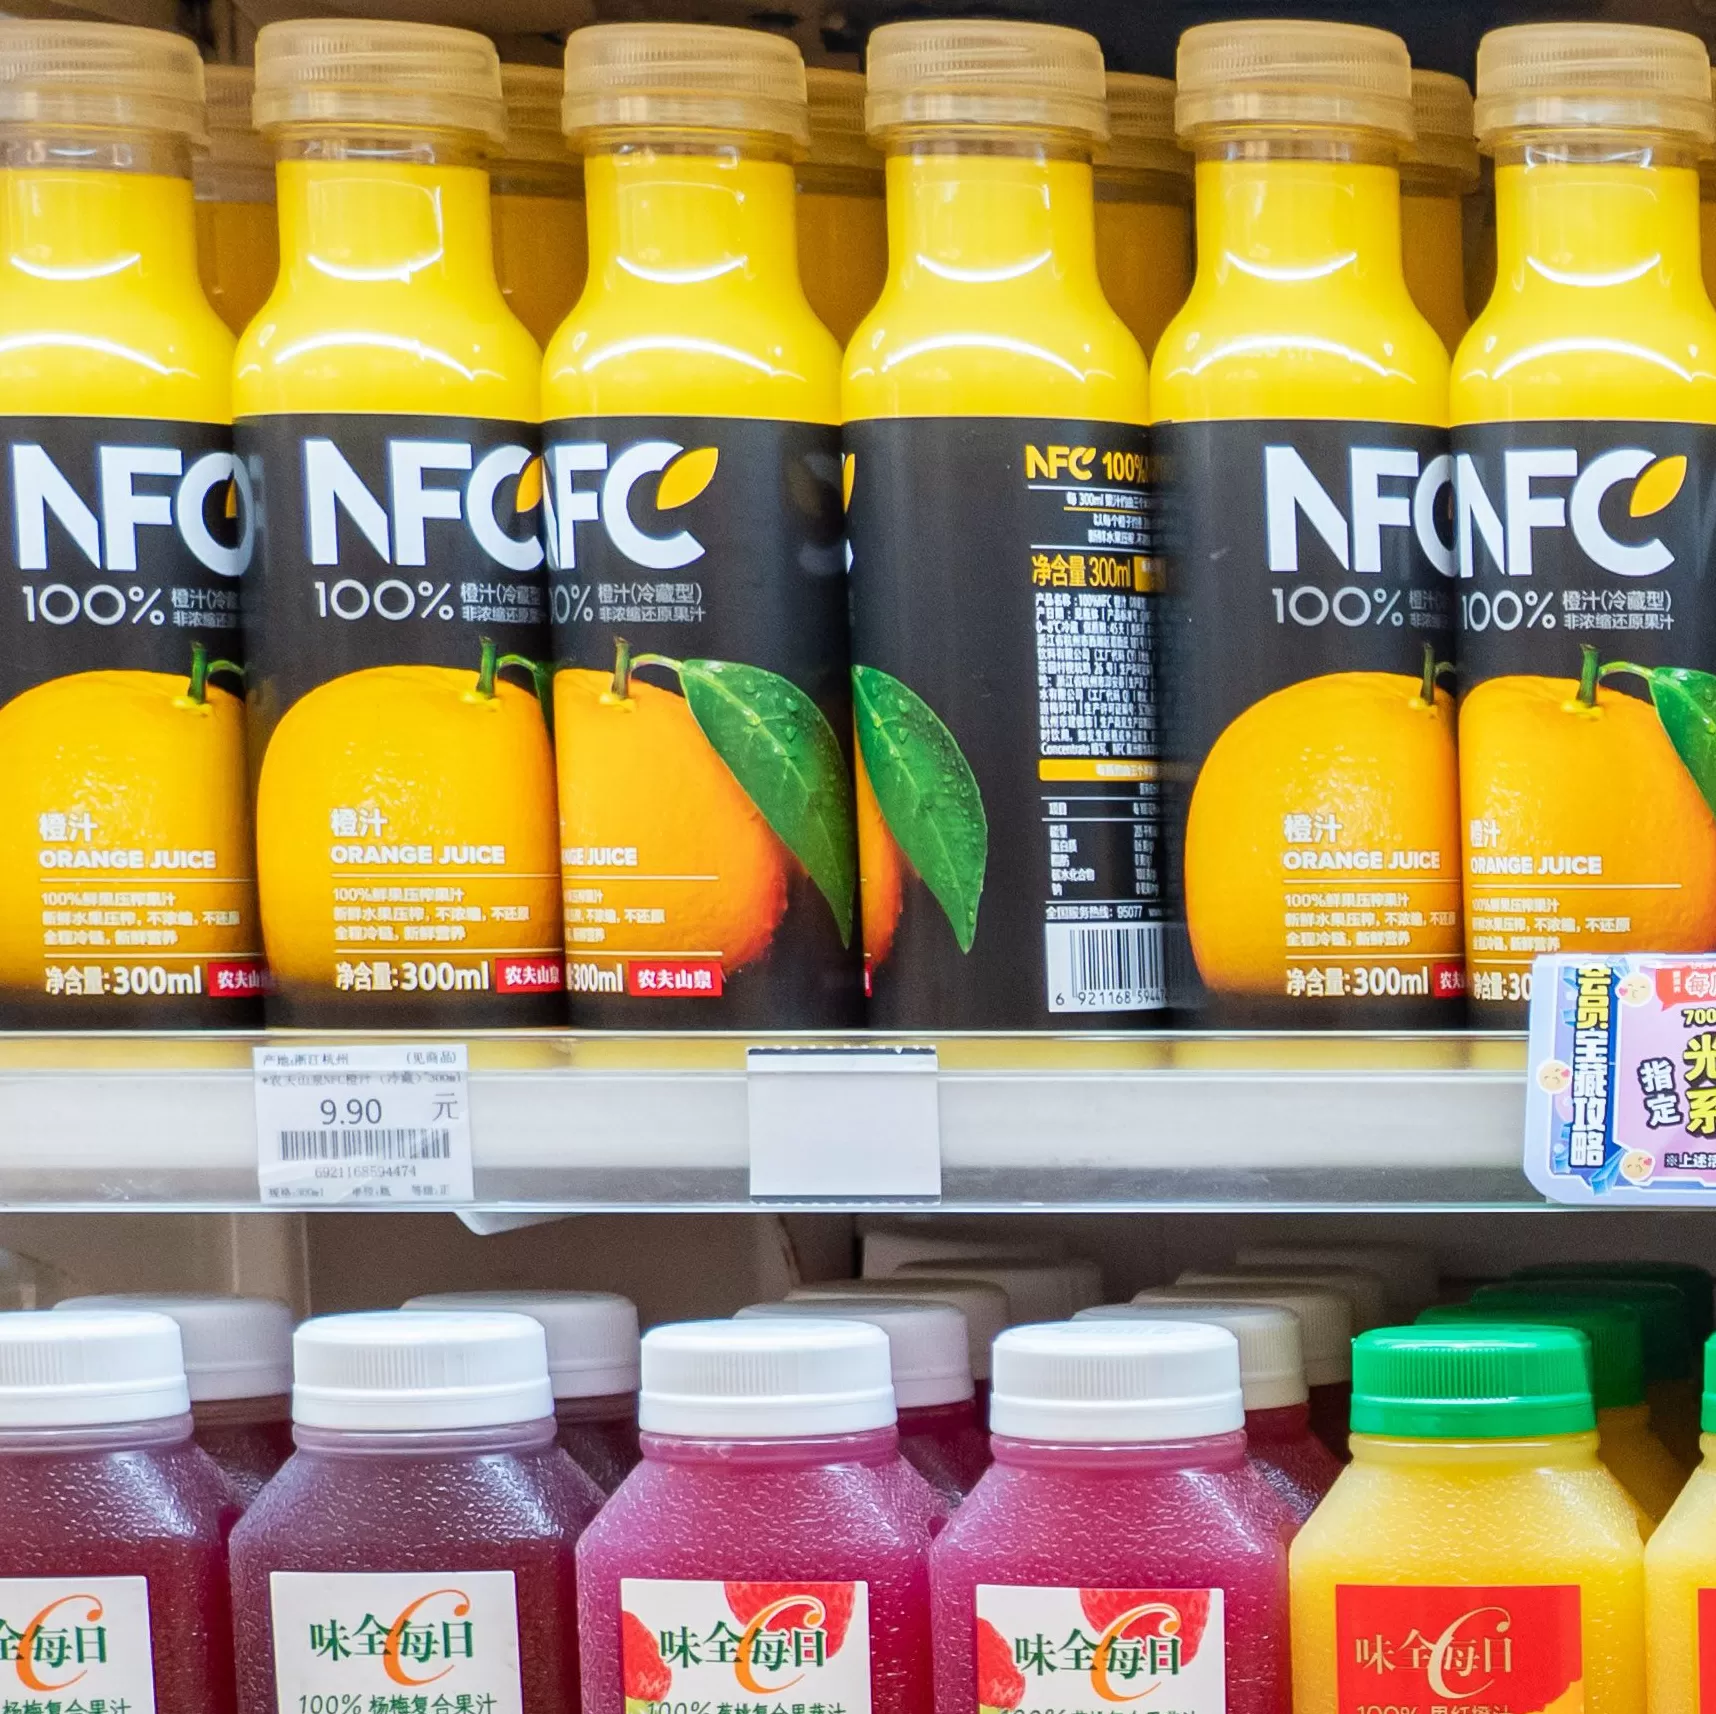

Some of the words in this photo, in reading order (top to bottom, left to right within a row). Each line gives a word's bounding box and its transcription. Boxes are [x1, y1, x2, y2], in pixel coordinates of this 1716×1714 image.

[23, 584, 164, 625] 100%
[315, 580, 454, 622] 100%
[330, 809, 387, 837] 橙汁
[39, 850, 144, 870] ORANGE
[150, 849, 216, 869] JUICE
[330, 845, 432, 865] ORANGE
[439, 845, 505, 865] JUICE
[638, 969, 712, 990] 农夫山泉
[319, 1098, 382, 1126] 9.90
[431, 1094, 460, 1122] 元
